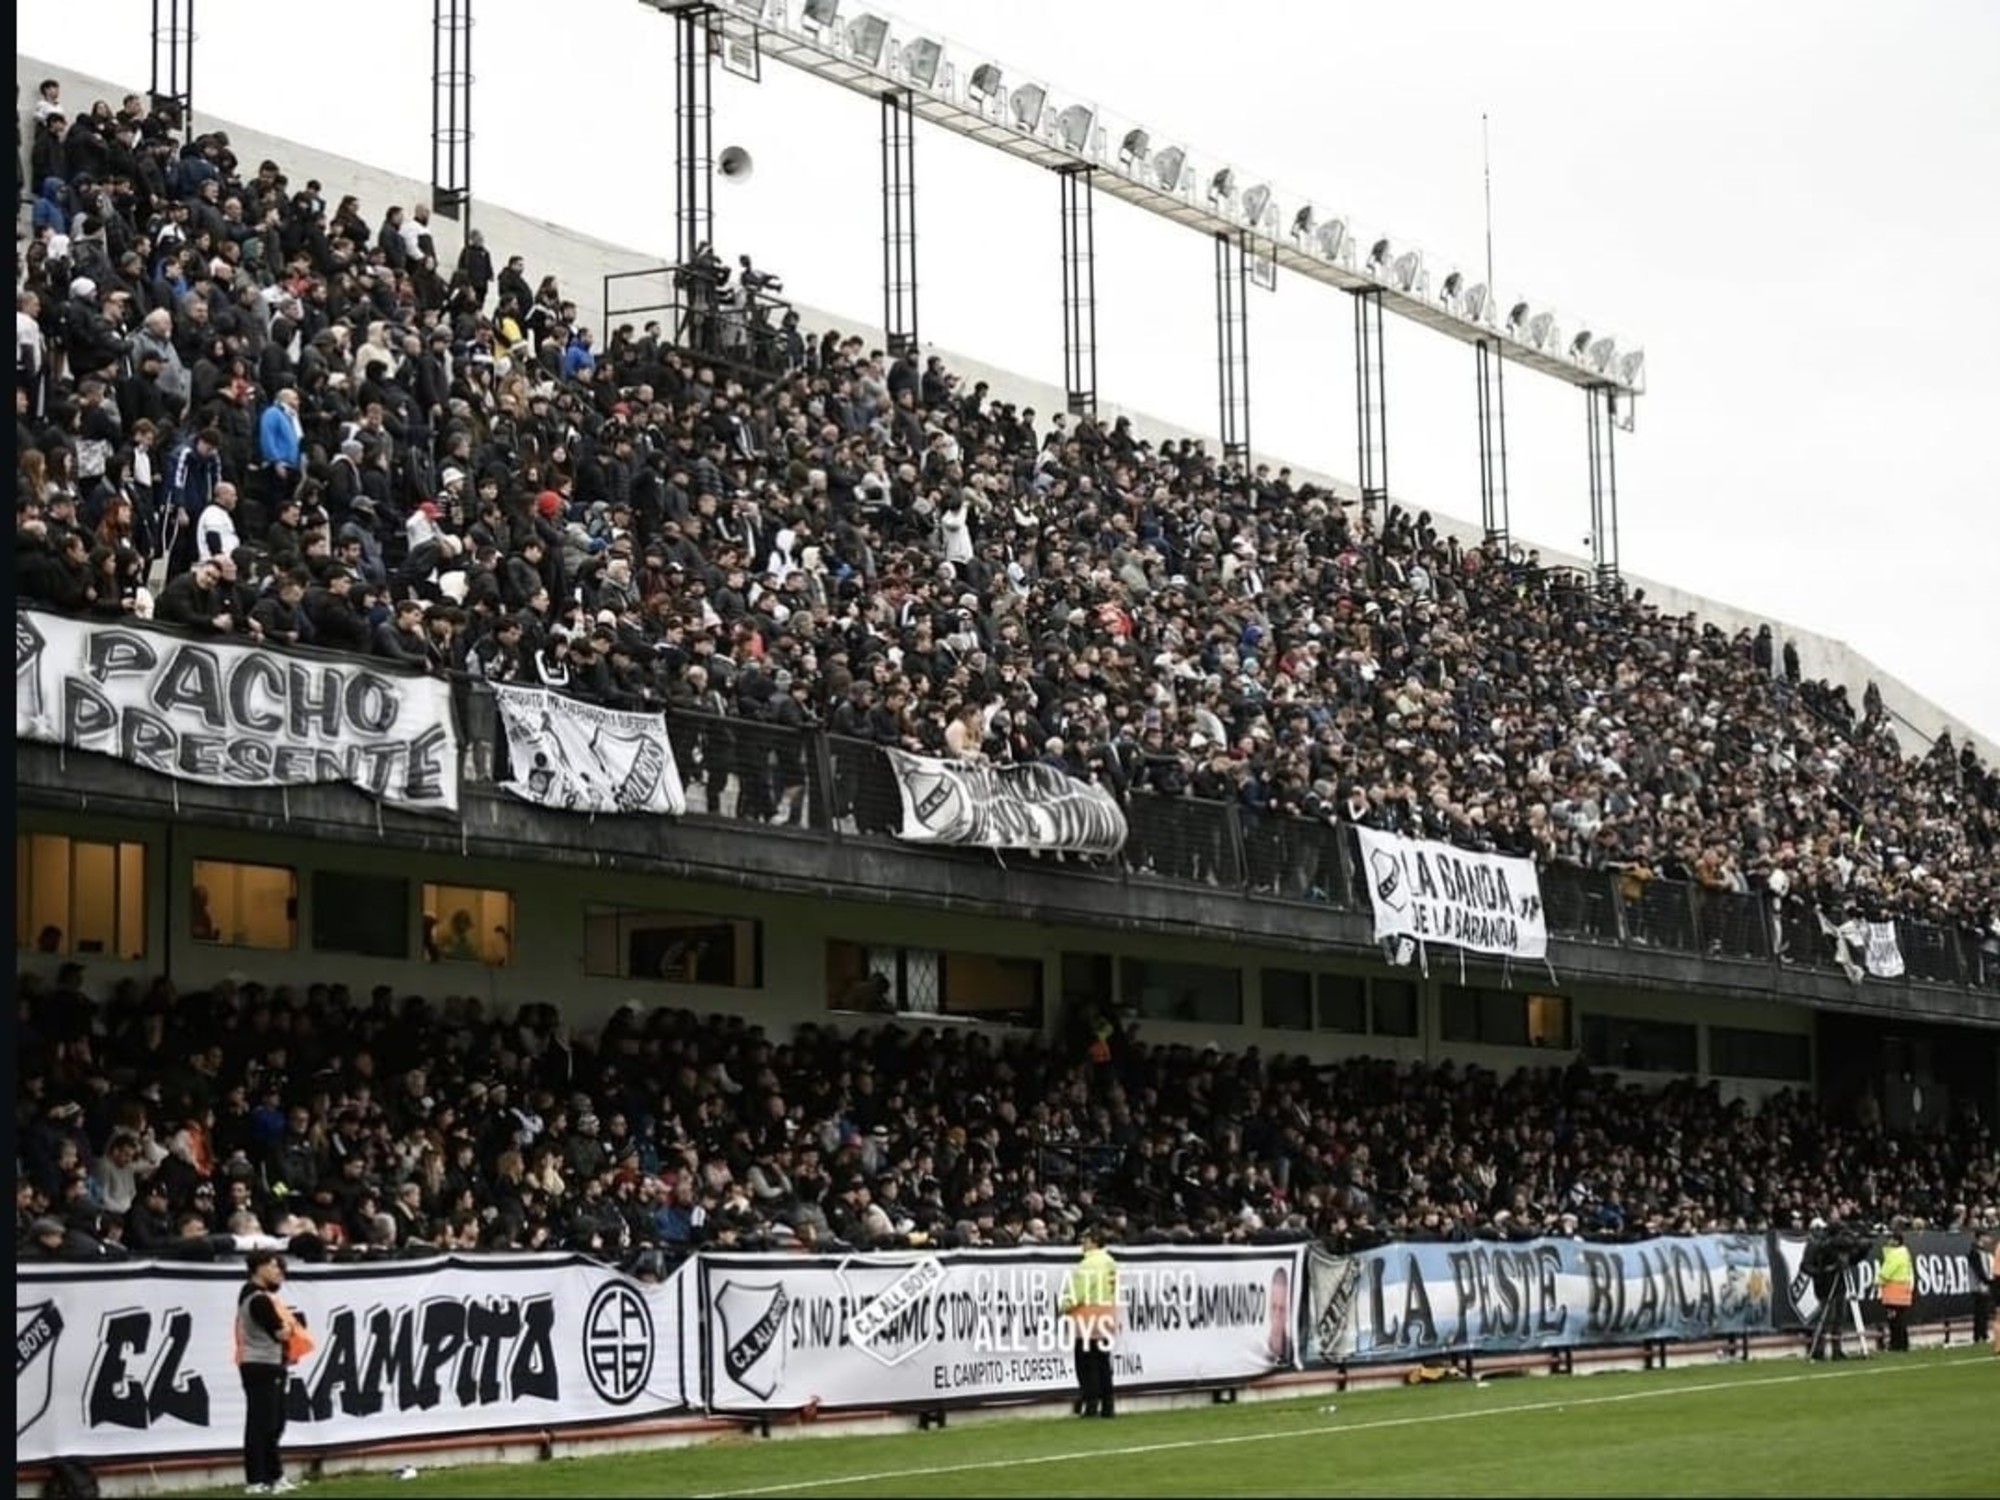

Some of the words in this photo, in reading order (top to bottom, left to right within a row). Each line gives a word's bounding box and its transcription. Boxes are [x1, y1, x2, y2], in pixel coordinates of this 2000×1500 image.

[88, 629, 400, 738] PACHO
[62, 675, 446, 800] PRESENTE
[1400, 849, 1438, 900] LA
[1432, 905, 1452, 937] LA
[792, 1296, 805, 1350] SI
[810, 1296, 834, 1348] NO
[1369, 1252, 1438, 1347] LA
[1448, 1245, 1568, 1345] PESTE
[17, 1317, 51, 1361] BOYS
[82, 1306, 210, 1430] EL
[286, 1292, 560, 1423] AMPITO
[934, 1365, 951, 1389] EL
[953, 1360, 1003, 1387] CAMPITO
[1011, 1357, 1069, 1383] FLORESTA
